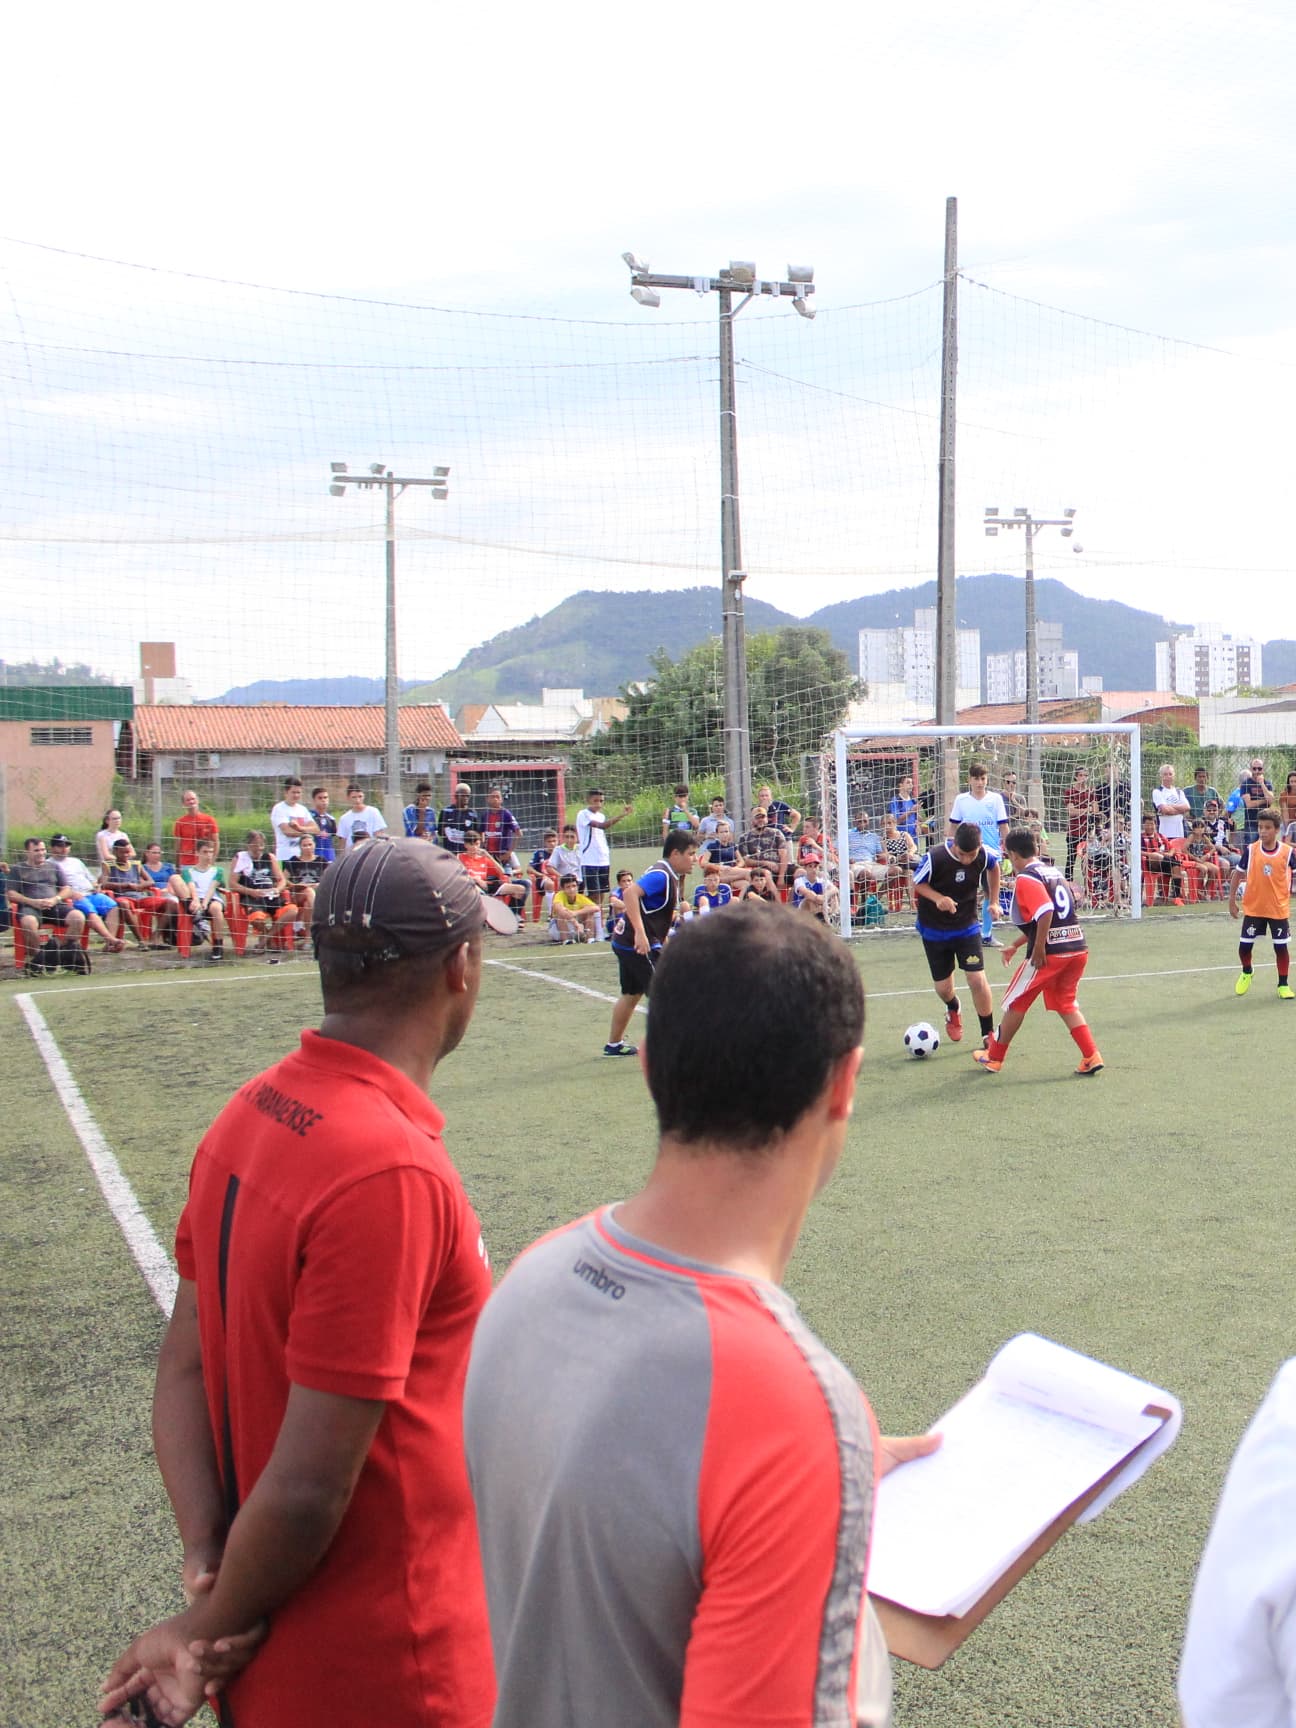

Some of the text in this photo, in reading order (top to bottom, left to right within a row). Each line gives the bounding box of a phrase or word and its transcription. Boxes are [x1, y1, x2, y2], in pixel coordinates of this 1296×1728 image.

[1055, 885, 1070, 920] 9
[1277, 928, 1283, 937] 7
[573, 1258, 626, 1301] umbro
